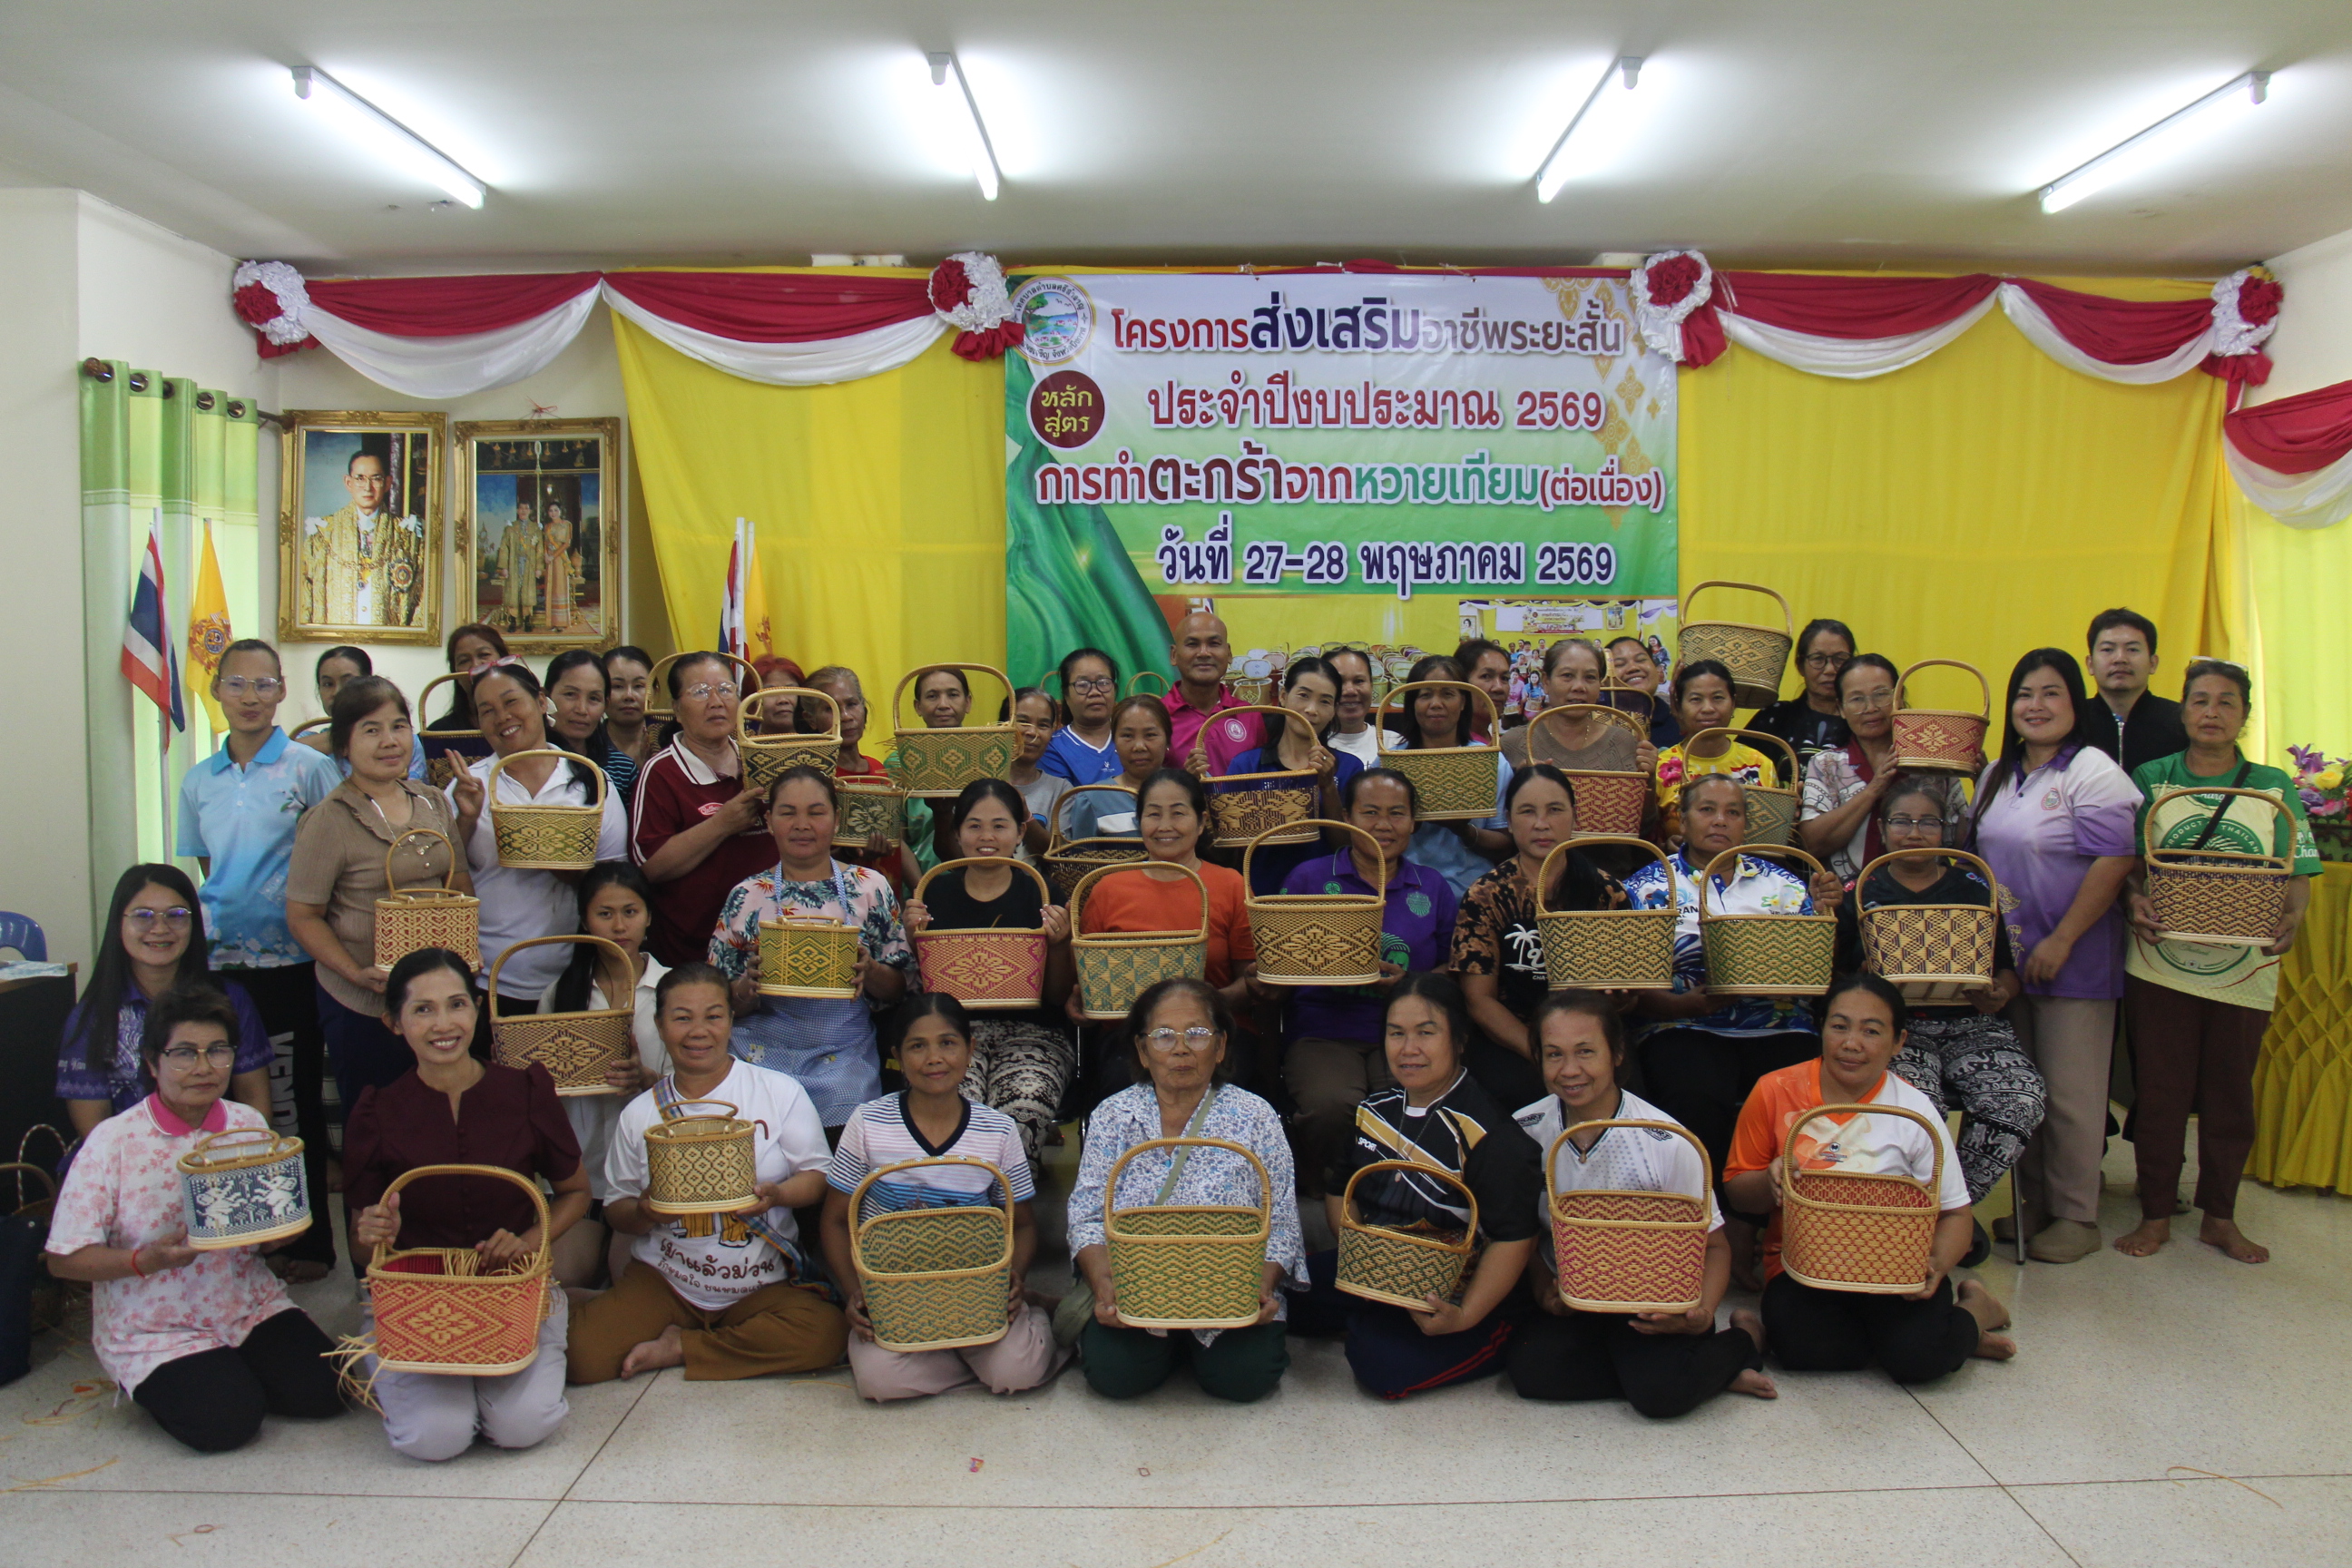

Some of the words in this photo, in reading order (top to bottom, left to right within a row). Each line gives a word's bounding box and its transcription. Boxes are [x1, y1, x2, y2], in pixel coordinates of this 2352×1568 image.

[1111, 290, 1621, 352] โครงการส่งเสริมอาชีพระยะสั้น
[1041, 385, 1093, 407] หลัก
[1147, 369, 1500, 426] ประจำปีงบประมาณ
[1516, 390, 1602, 427] 2569
[1044, 408, 1091, 438] สูตร
[1158, 514, 1229, 580] วันที่
[1245, 544, 1345, 581] 27-28
[1360, 544, 1521, 596] พฤษภาคม
[1538, 545, 1612, 581] 2569
[2220, 824, 2260, 855] THAILAN
[1357, 1136, 1377, 1152] SPORT
